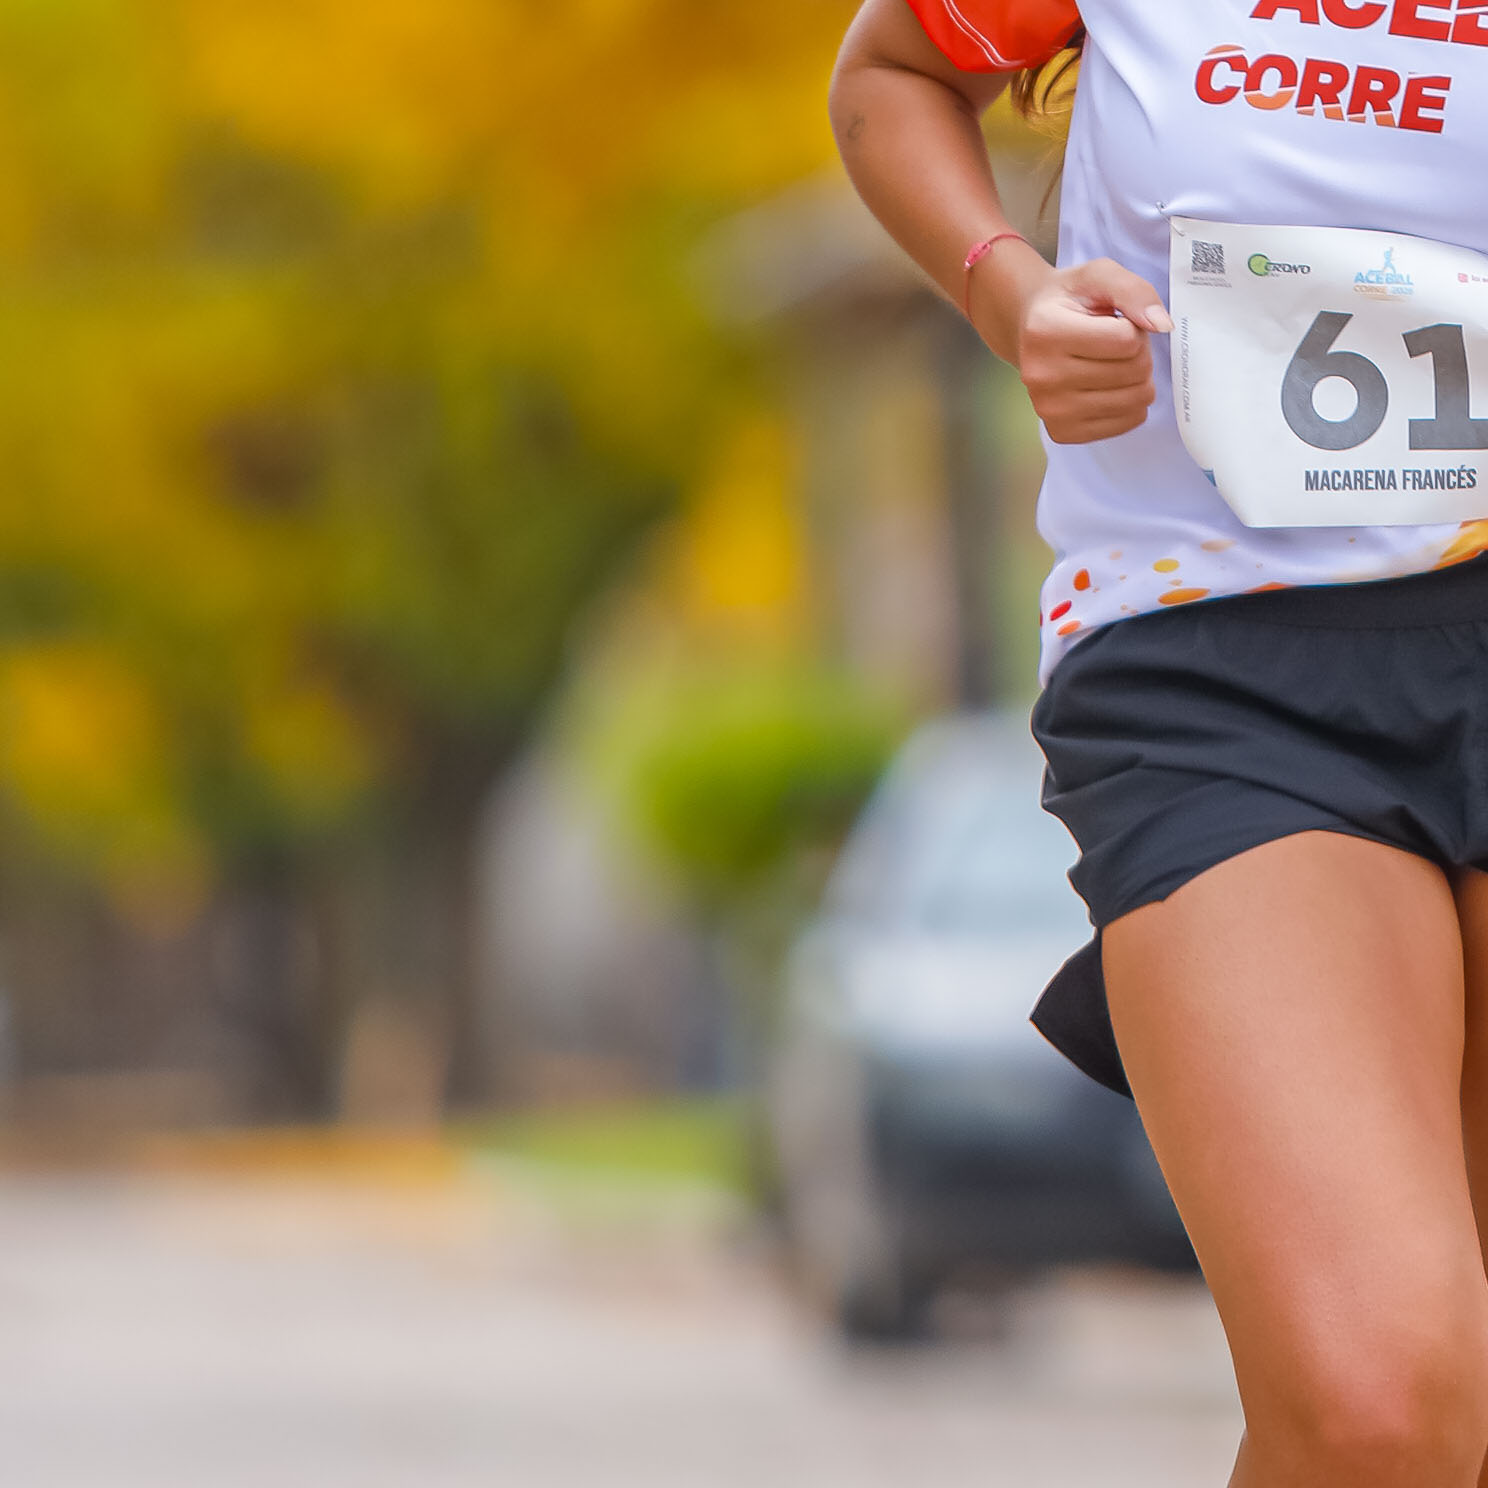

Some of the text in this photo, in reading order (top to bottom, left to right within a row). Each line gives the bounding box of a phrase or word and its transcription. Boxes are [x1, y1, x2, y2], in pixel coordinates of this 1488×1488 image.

[1194, 44, 1452, 134] CORRE
[1304, 464, 1477, 491] MACARENA FRANCÉS
